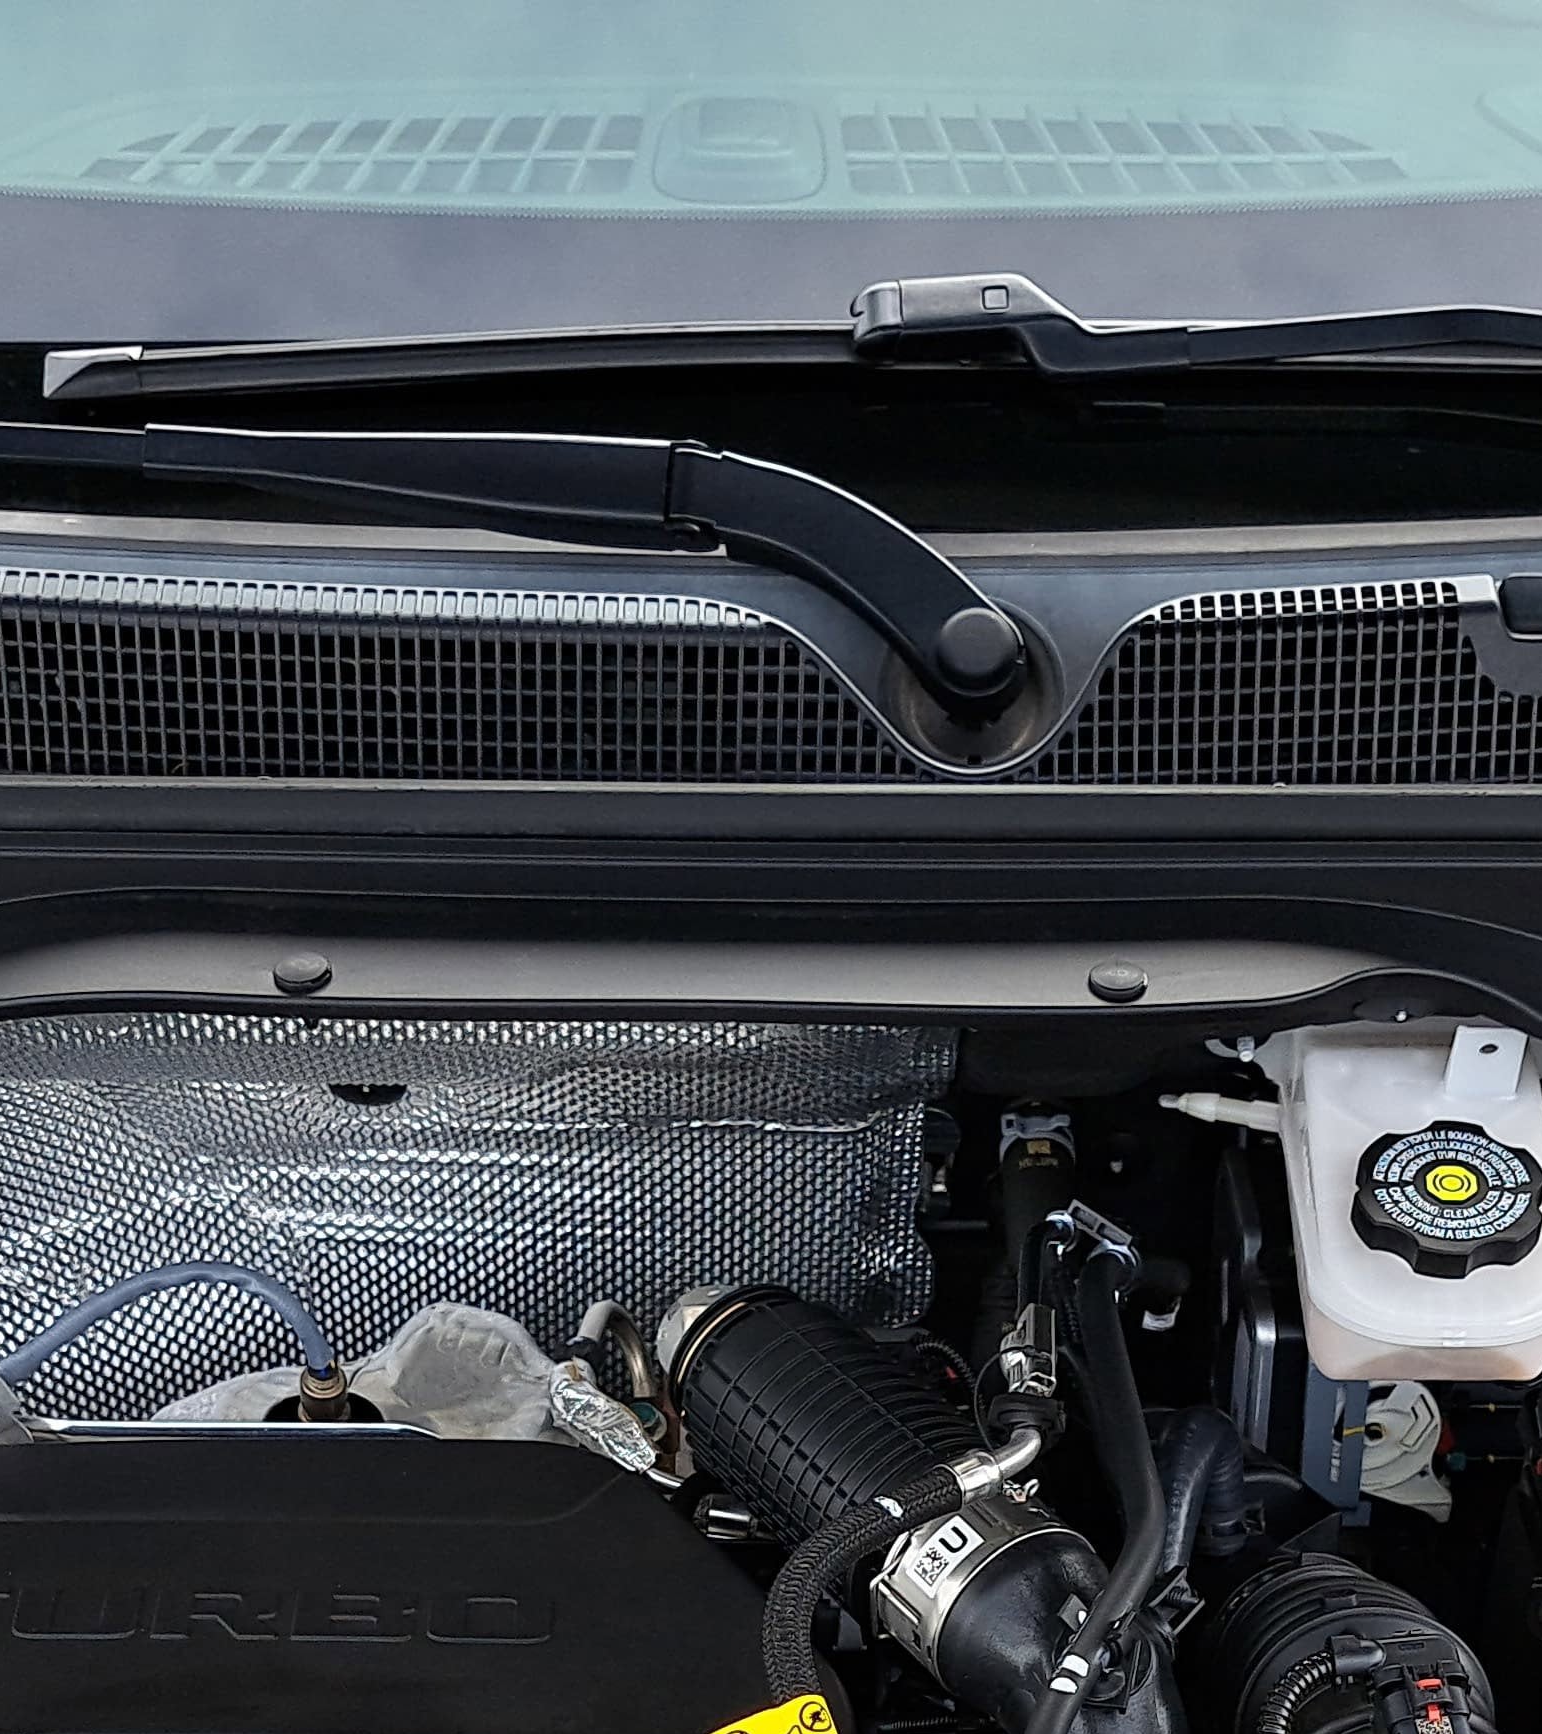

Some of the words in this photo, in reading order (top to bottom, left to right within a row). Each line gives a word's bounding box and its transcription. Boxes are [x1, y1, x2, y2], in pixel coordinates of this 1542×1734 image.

[1387, 1206, 1416, 1227] FLUID
[1413, 1222, 1446, 1239] FROM
[1399, 1200, 1433, 1224] BEFORE
[1443, 1207, 1478, 1219] CLEAN
[938, 1525, 968, 1553] U
